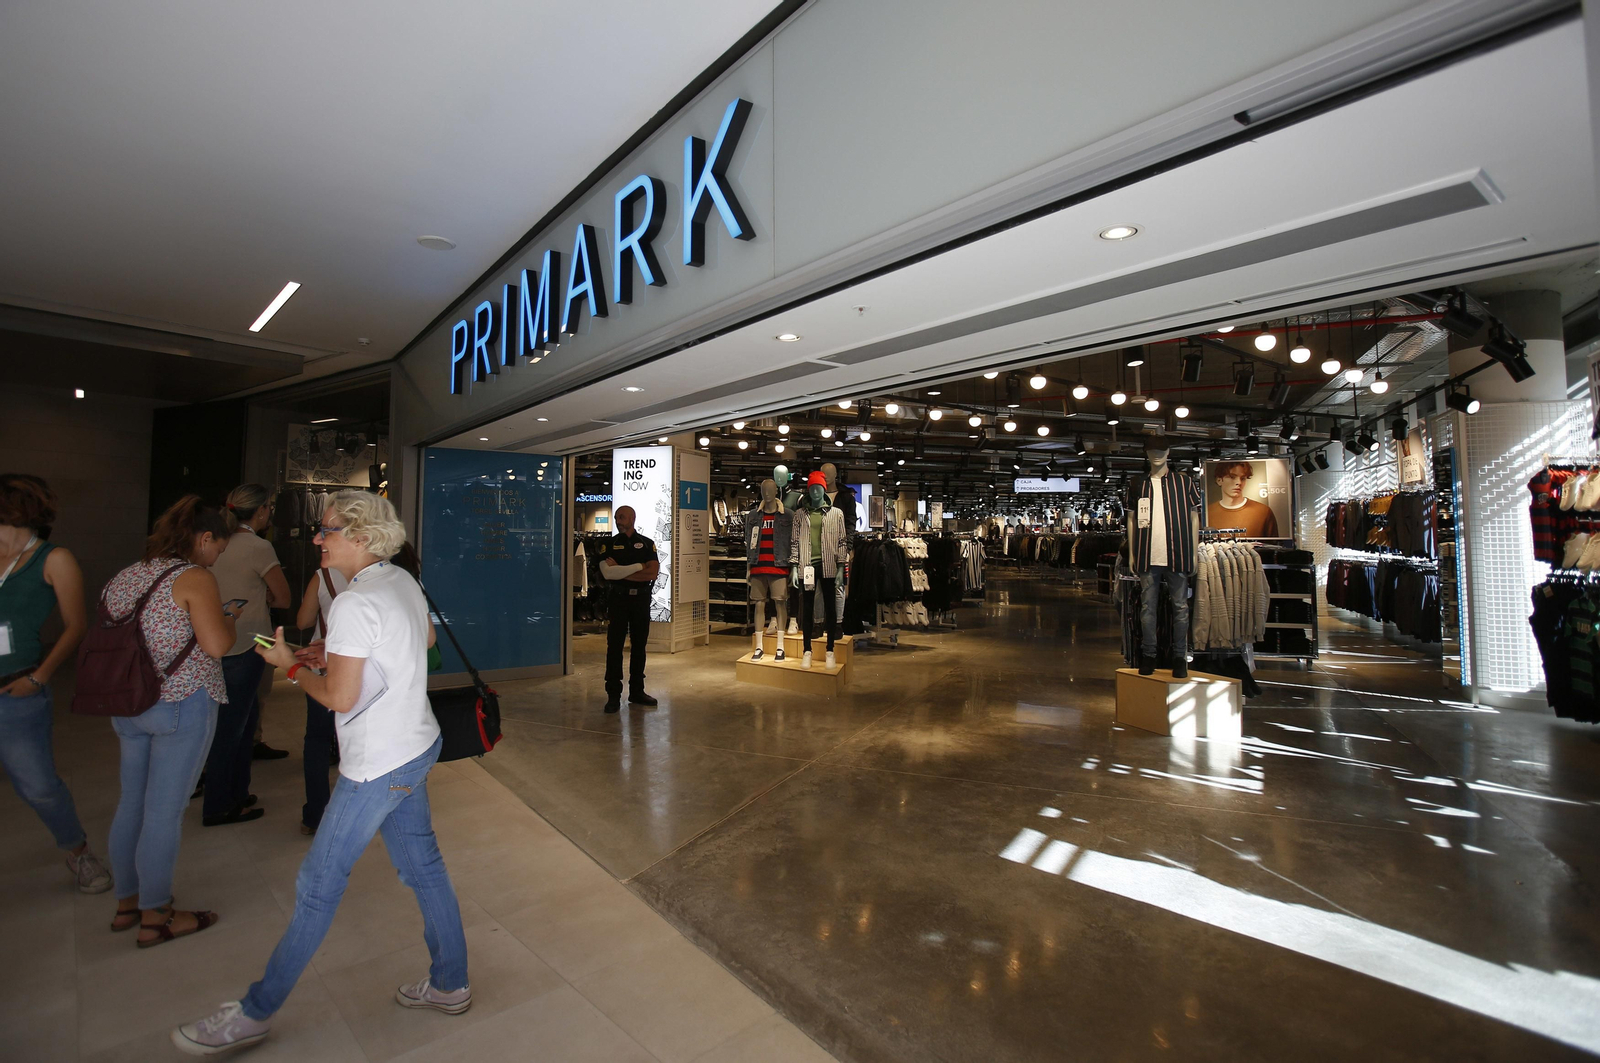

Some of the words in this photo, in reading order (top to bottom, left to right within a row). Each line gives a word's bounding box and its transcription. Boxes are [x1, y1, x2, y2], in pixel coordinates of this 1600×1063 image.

[450, 97, 757, 395] PRIMARK
[623, 459, 657, 469] TREND
[623, 470, 643, 480] ING
[623, 481, 649, 491] NOW
[685, 487, 691, 504] 1
[462, 496, 527, 507] PRIMARK
